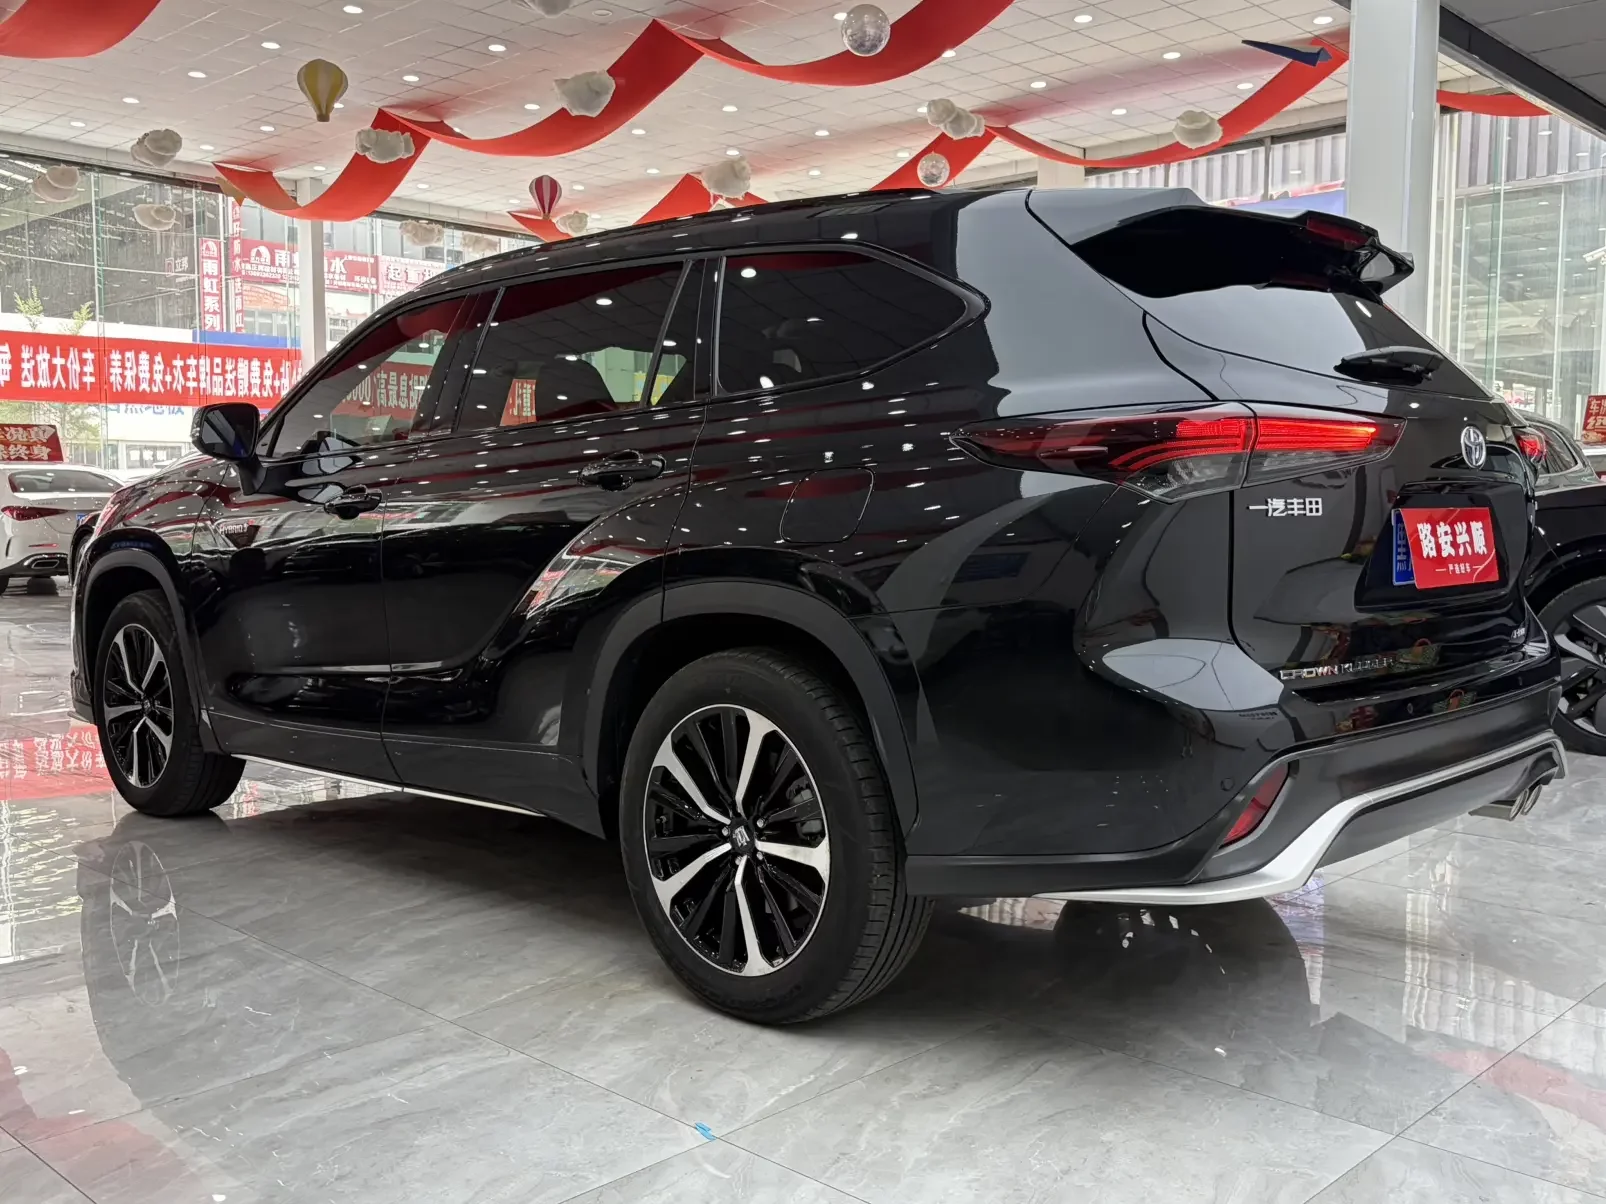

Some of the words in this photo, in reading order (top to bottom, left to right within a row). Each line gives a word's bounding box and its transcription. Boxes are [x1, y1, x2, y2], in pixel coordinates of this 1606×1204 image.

[202, 259, 221, 331] 雨虹系列
[1247, 497, 1323, 517] 一汽丰田
[1416, 520, 1489, 560] 路安兴顺
[1279, 664, 1339, 680] CROWN
